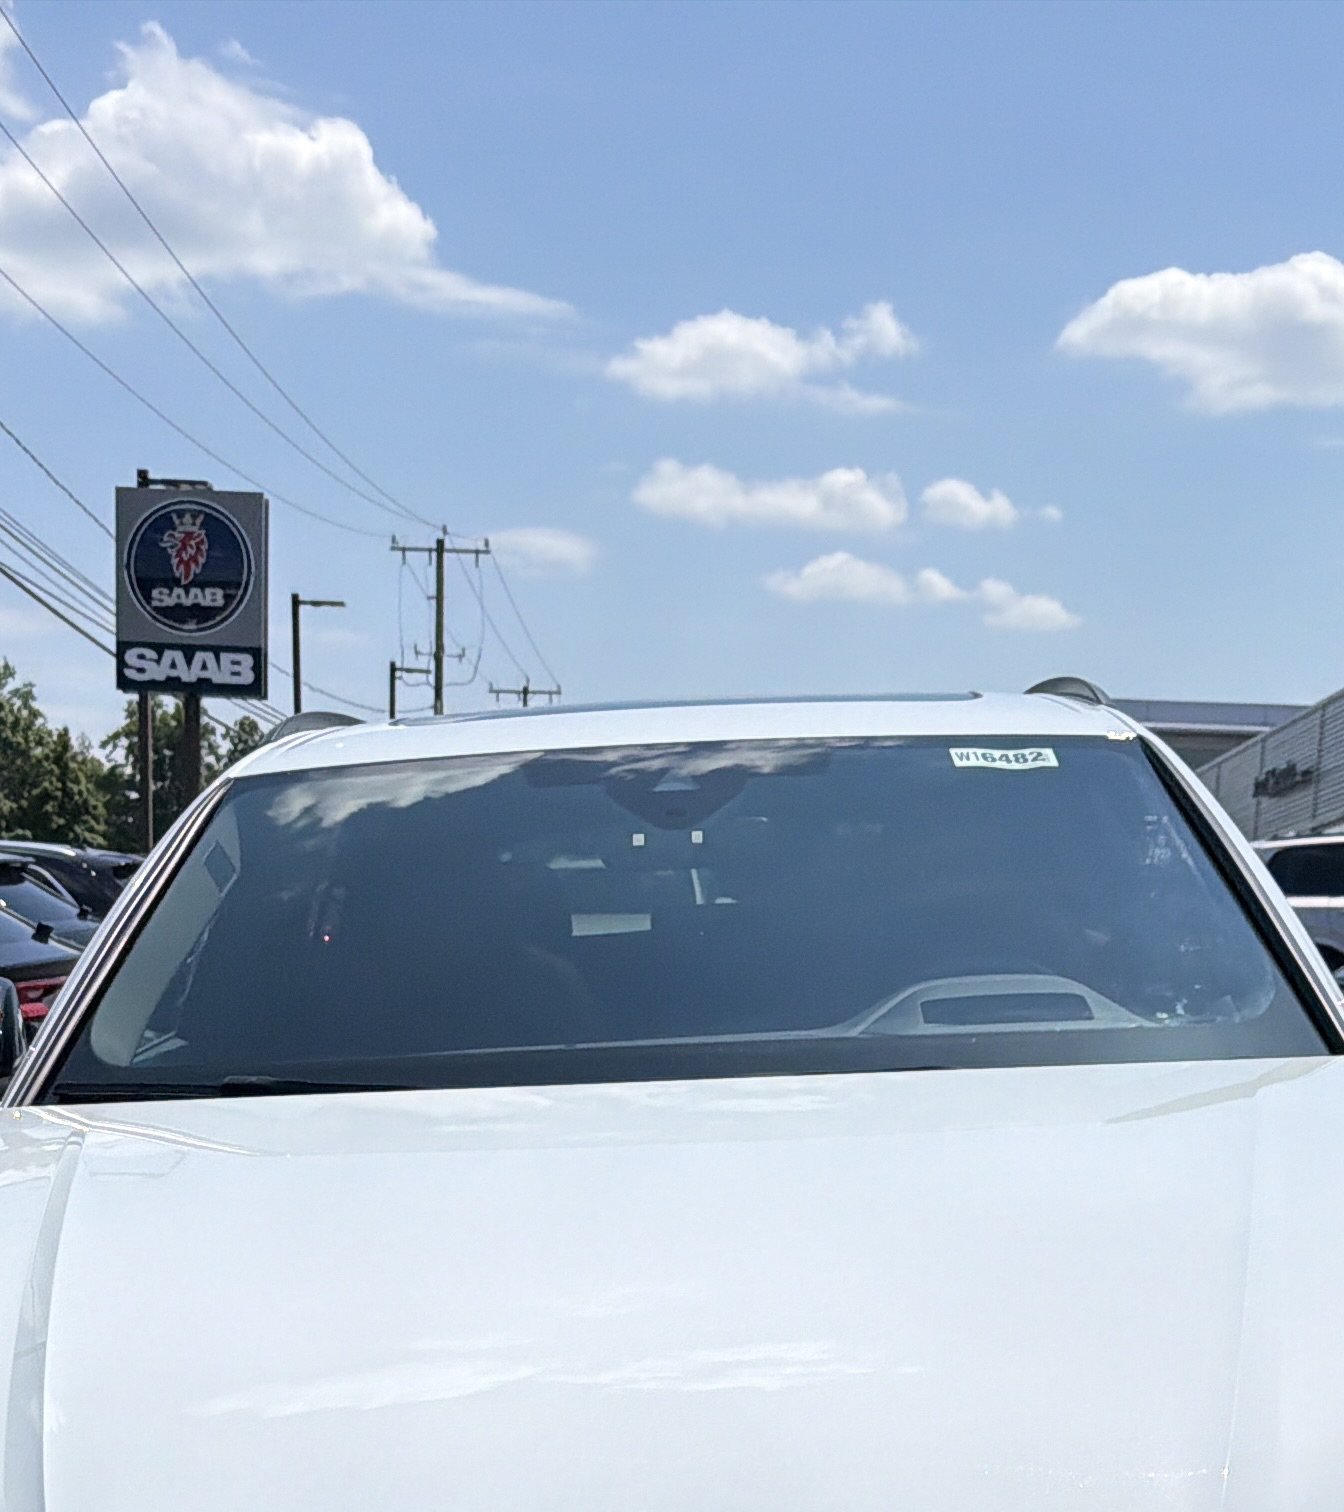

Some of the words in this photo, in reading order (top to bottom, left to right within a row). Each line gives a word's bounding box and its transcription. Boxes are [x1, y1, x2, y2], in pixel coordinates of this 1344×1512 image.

[151, 586, 225, 608] SAAB
[123, 647, 256, 685] SAAB
[954, 751, 1047, 765] W16482
